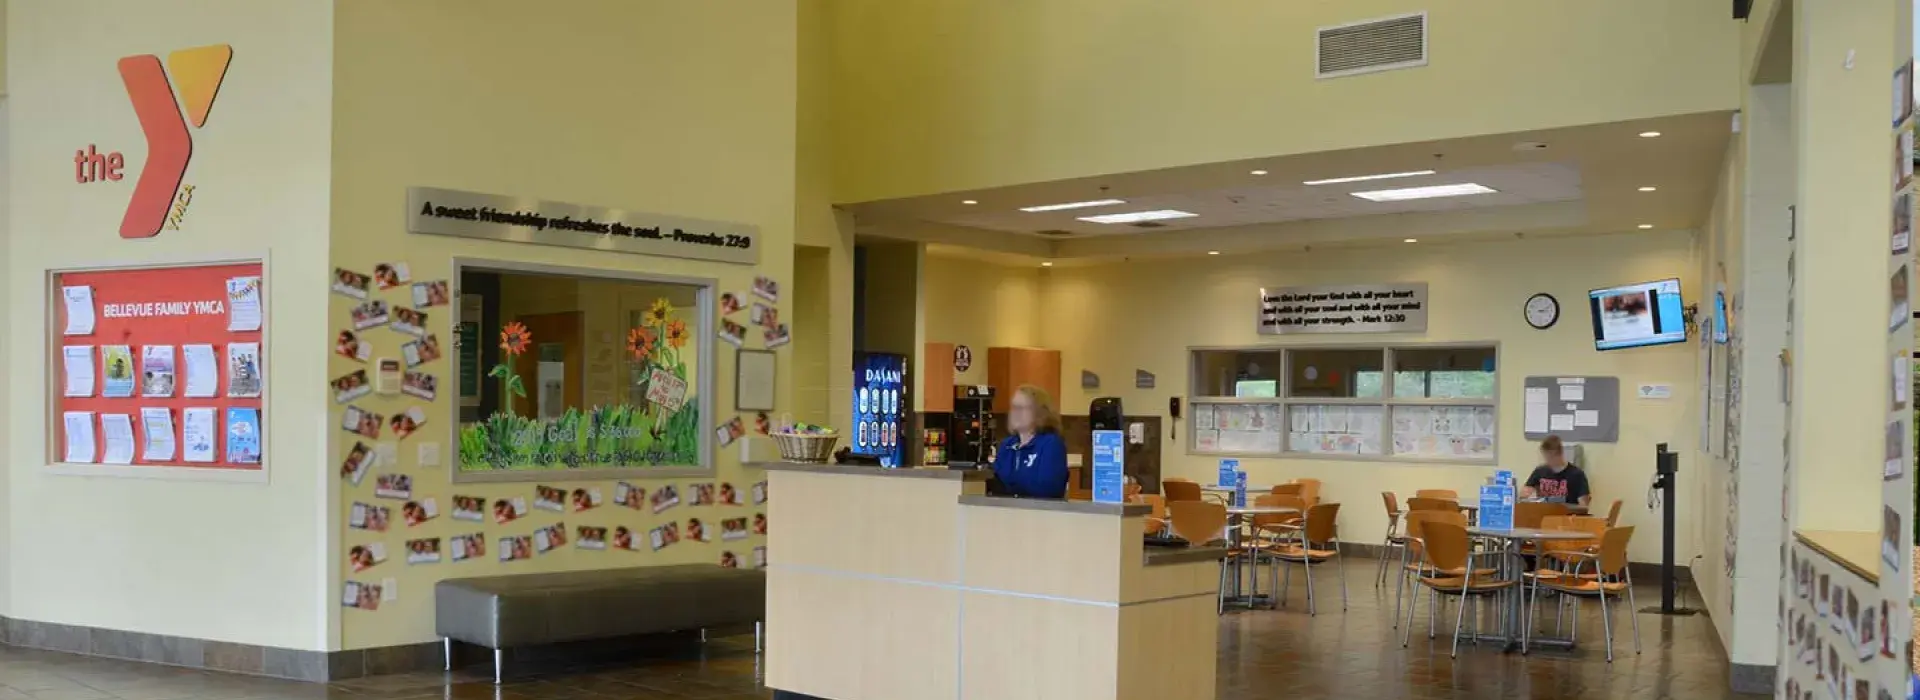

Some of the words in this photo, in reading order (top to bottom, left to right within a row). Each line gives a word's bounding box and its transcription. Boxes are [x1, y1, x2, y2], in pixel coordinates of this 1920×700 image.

[74, 143, 124, 184] the
[420, 201, 433, 216] A
[435, 205, 479, 220] sweet
[480, 206, 547, 230] friendship
[549, 215, 609, 234] refreshes
[611, 222, 632, 236] the
[673, 229, 725, 247] Proverbs
[1294, 293, 1311, 302] Lord
[1311, 294, 1328, 303] your
[1329, 291, 1344, 301] God
[1346, 290, 1362, 300] with
[1364, 290, 1373, 299] all
[1374, 291, 1391, 301] your
[1392, 289, 1414, 299] heart
[103, 302, 153, 318] BELLEVUE
[155, 301, 191, 316] FAMILY
[193, 299, 225, 315] YMCA
[1263, 305, 1276, 314] and
[1278, 305, 1293, 314] with
[1294, 304, 1303, 313] all
[1303, 306, 1320, 315] your
[1339, 303, 1353, 312] and
[1355, 302, 1371, 311] with
[1372, 302, 1381, 311] all
[1382, 304, 1399, 313] your
[1401, 301, 1421, 311] mind
[1263, 317, 1276, 326] and
[1277, 317, 1292, 325] with
[1294, 316, 1303, 325] all
[1303, 317, 1320, 327] your
[1362, 314, 1382, 323] Mark
[1383, 313, 1406, 323] 12:30
[865, 367, 901, 385] DASANI
